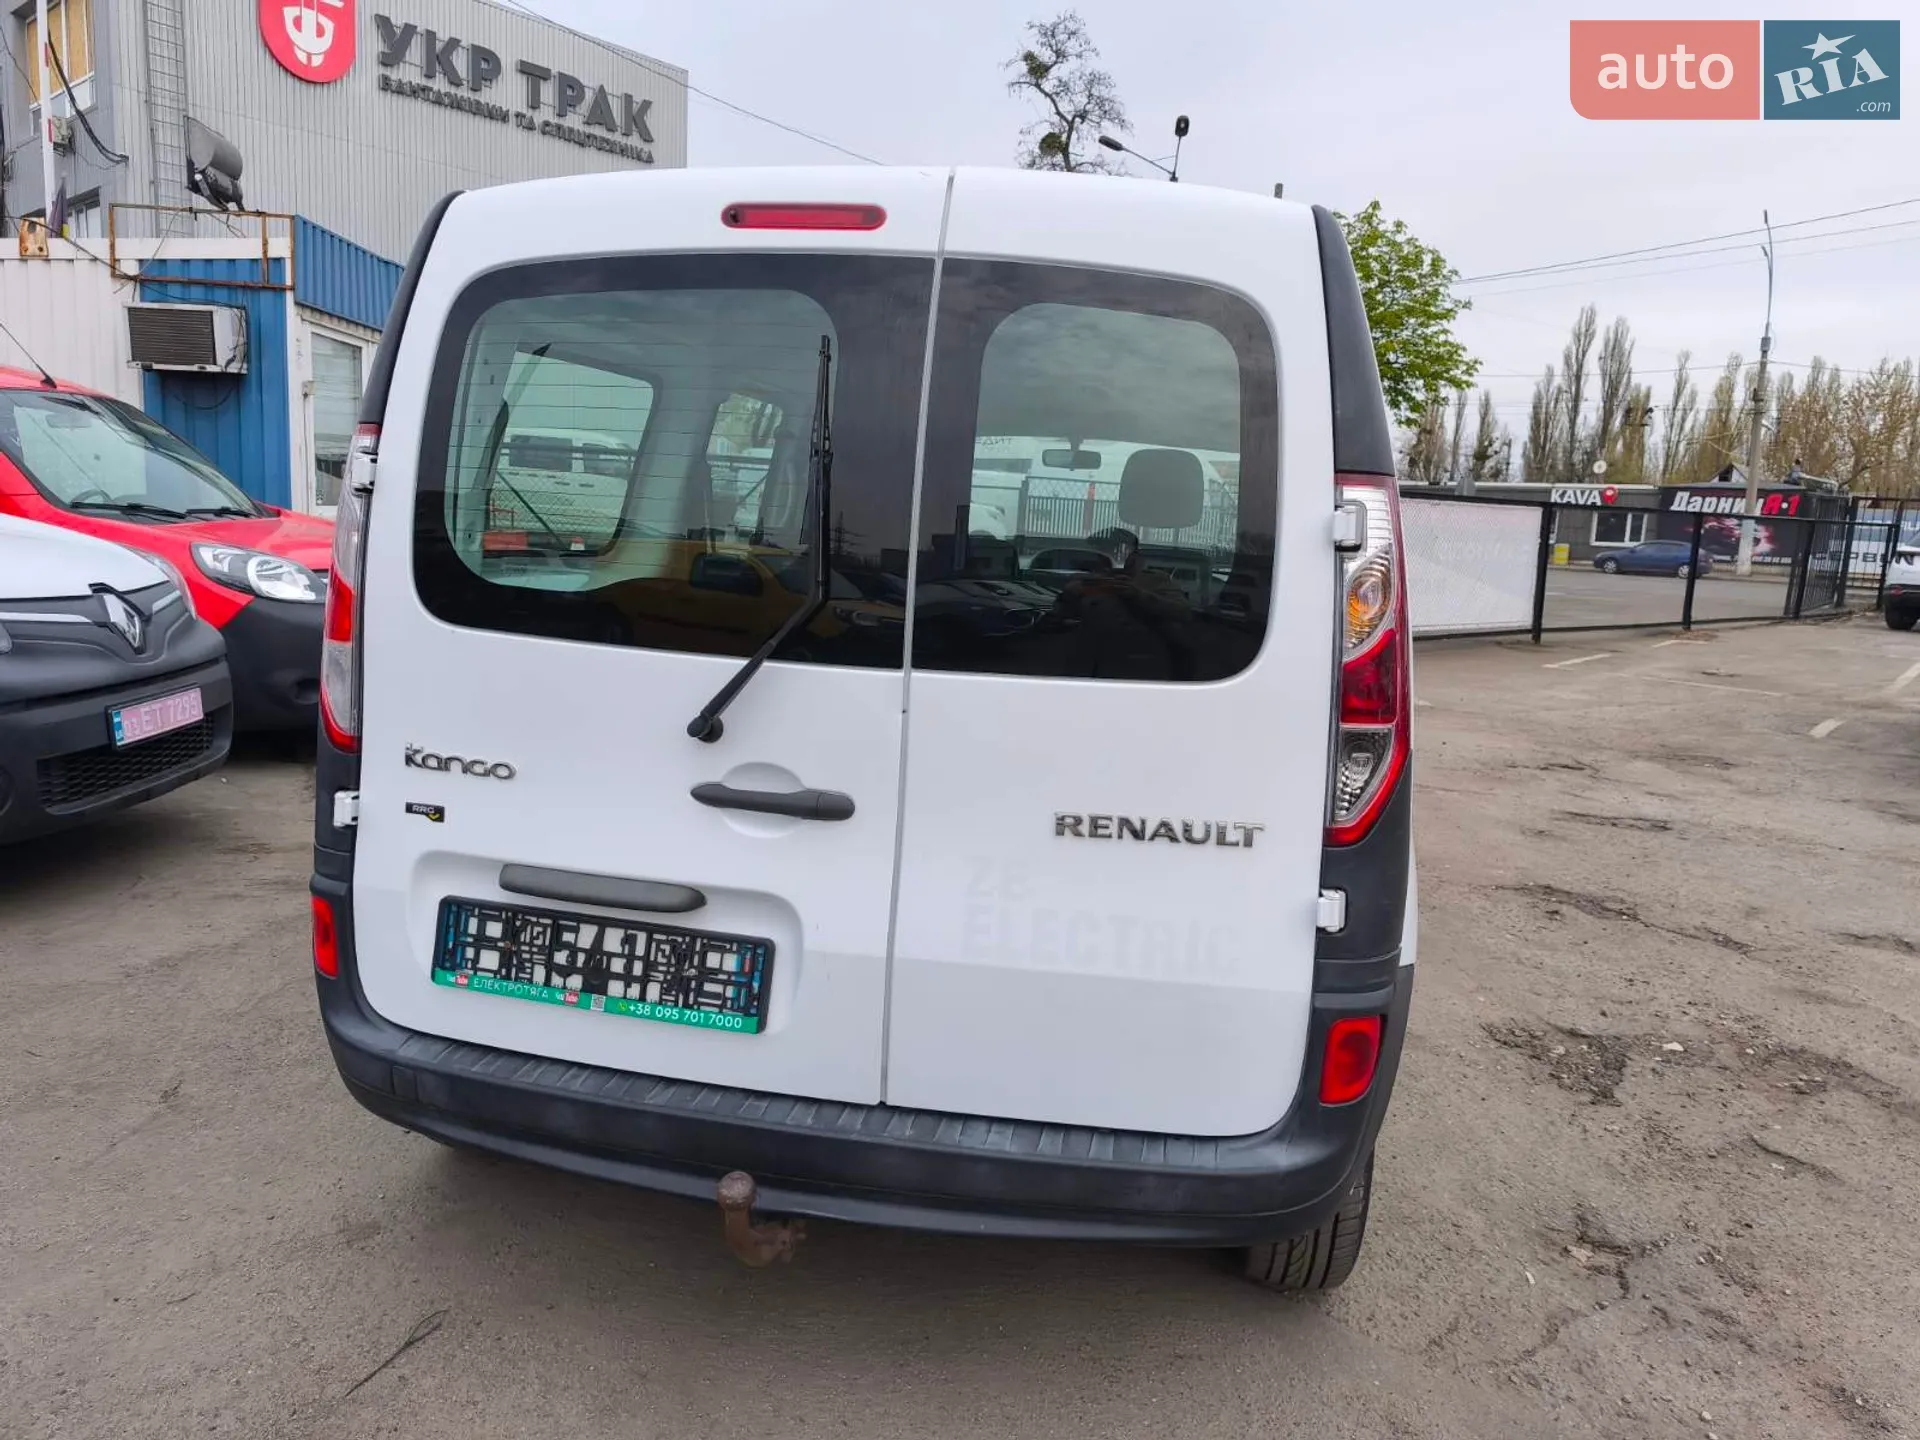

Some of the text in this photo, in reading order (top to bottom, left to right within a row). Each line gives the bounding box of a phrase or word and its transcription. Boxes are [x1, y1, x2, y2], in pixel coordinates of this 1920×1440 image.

[374, 13, 654, 143] УКР ТРАК
[1550, 487, 1603, 506] KAVA
[1054, 811, 1265, 849] RENAULT
[473, 977, 549, 999] ЕЛЕКТРОТЯГА
[628, 1003, 742, 1029] +38 095 701 7000
